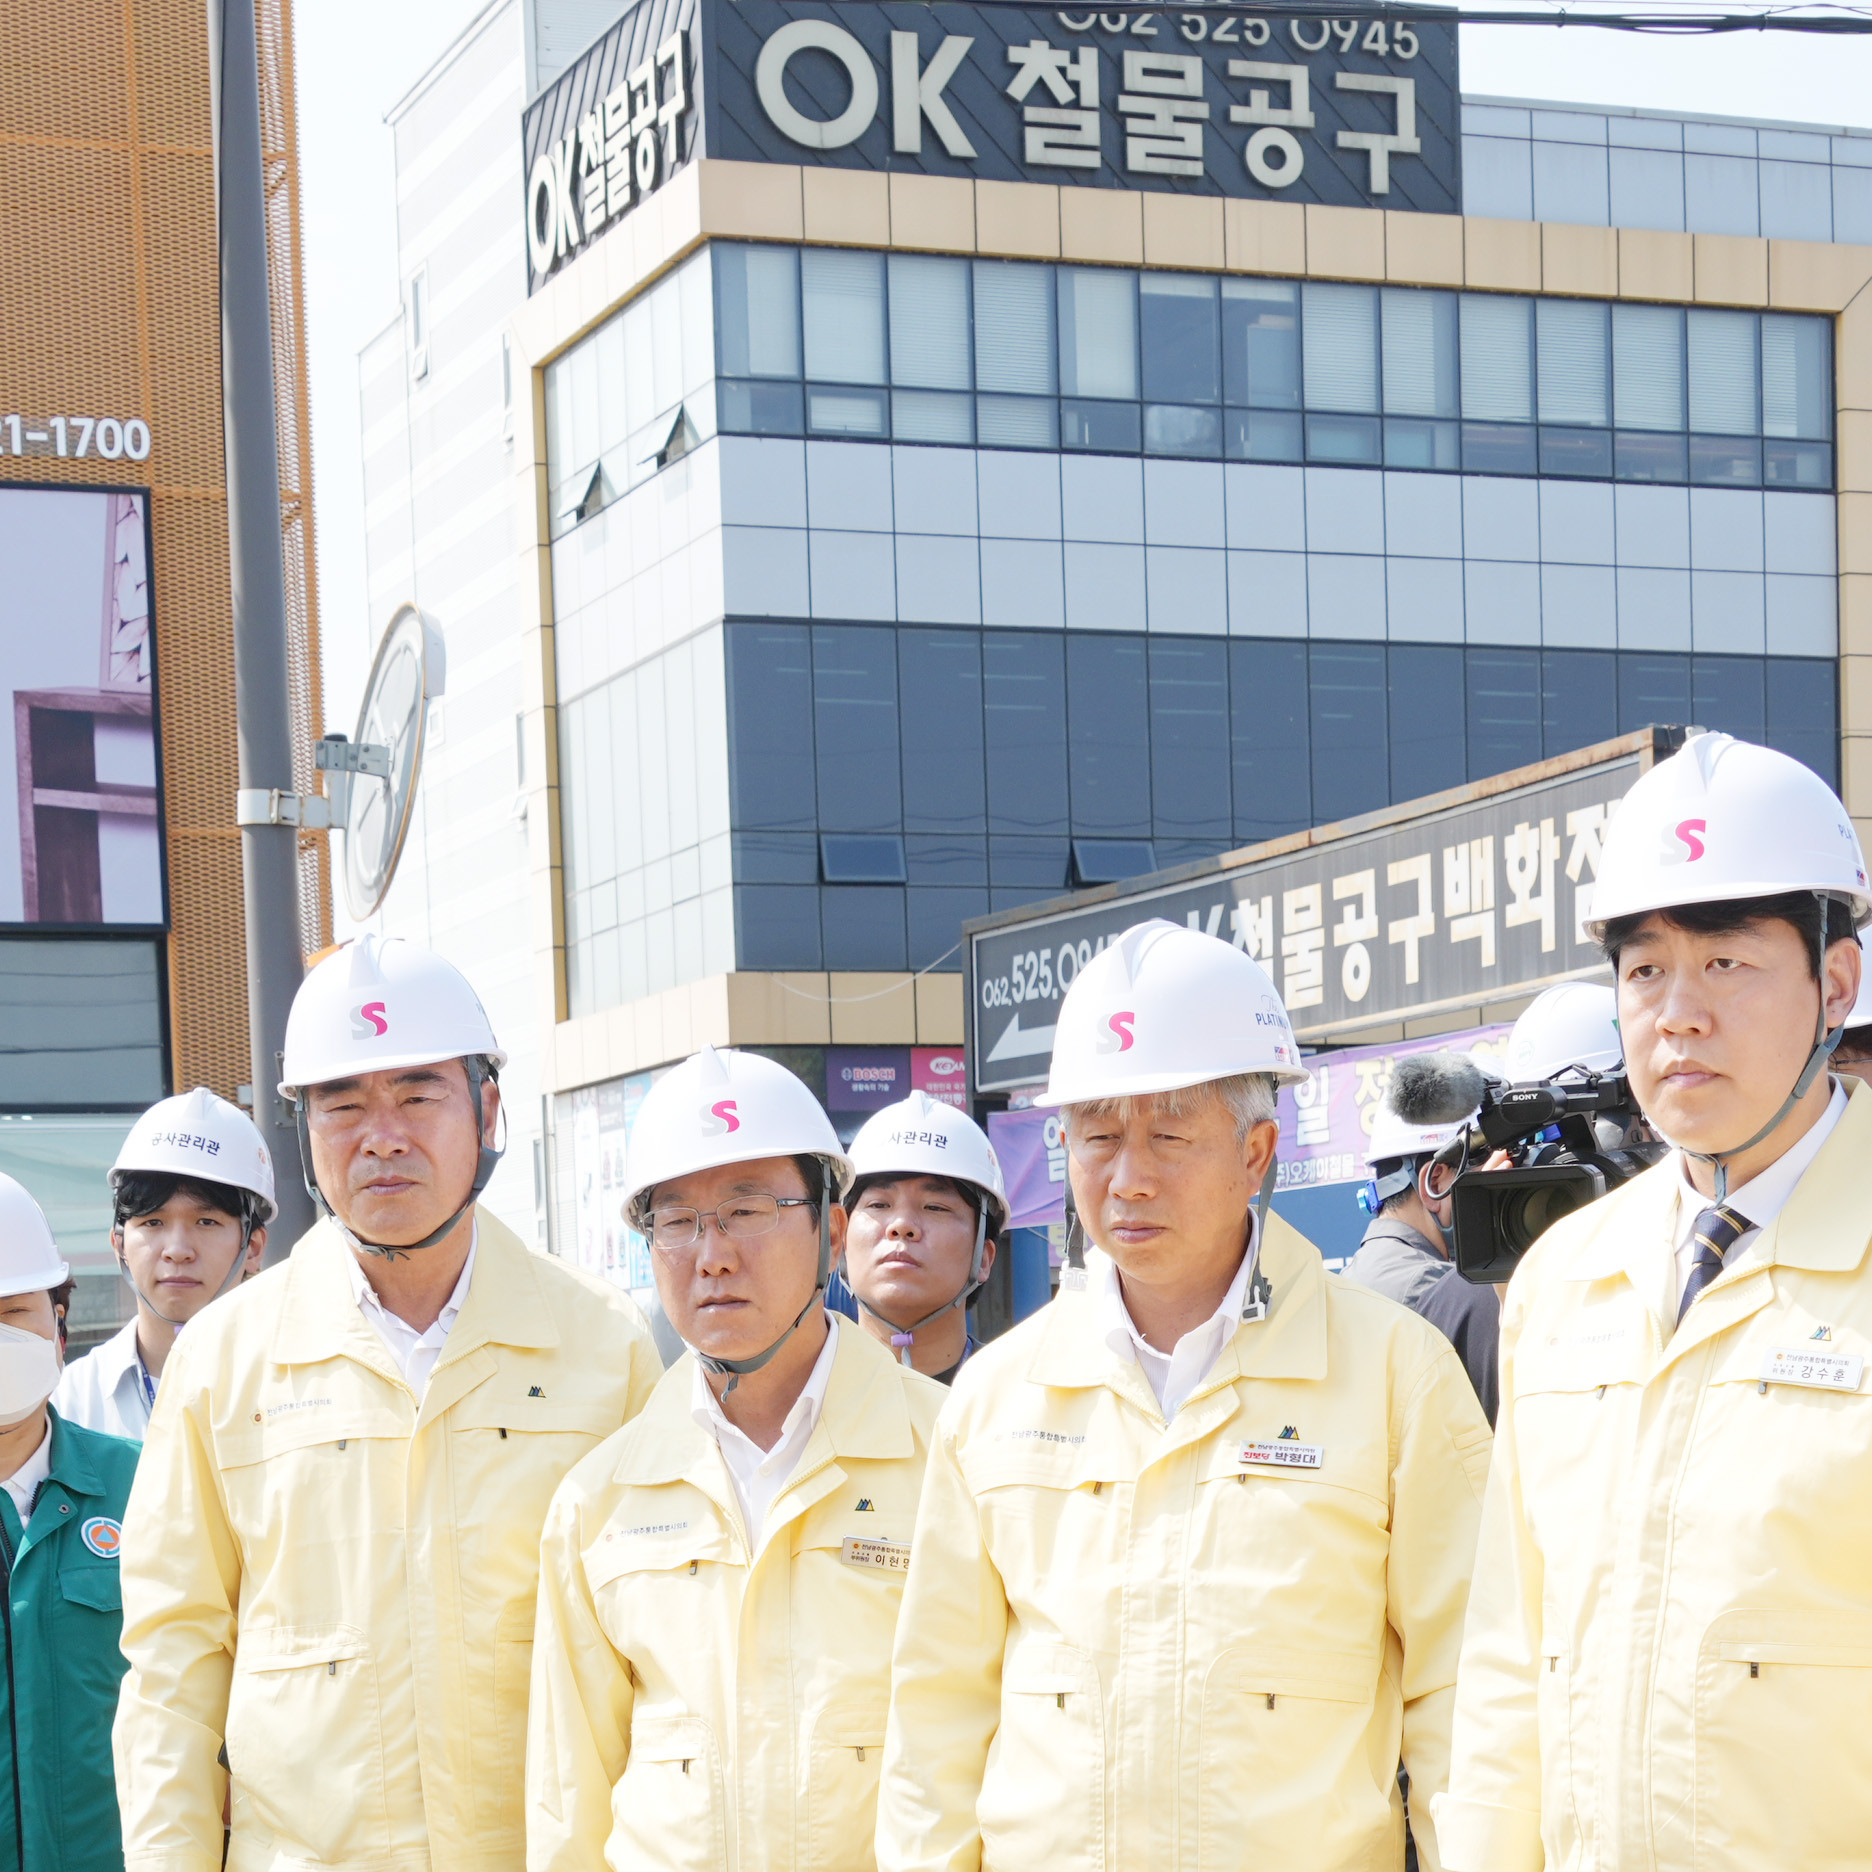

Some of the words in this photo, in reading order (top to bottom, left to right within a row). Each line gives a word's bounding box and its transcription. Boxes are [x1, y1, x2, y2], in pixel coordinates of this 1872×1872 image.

[852, 1067, 896, 1082] BOSCH
[1511, 1092, 1539, 1102] SONY
[151, 1132, 222, 1157] 공사관리관
